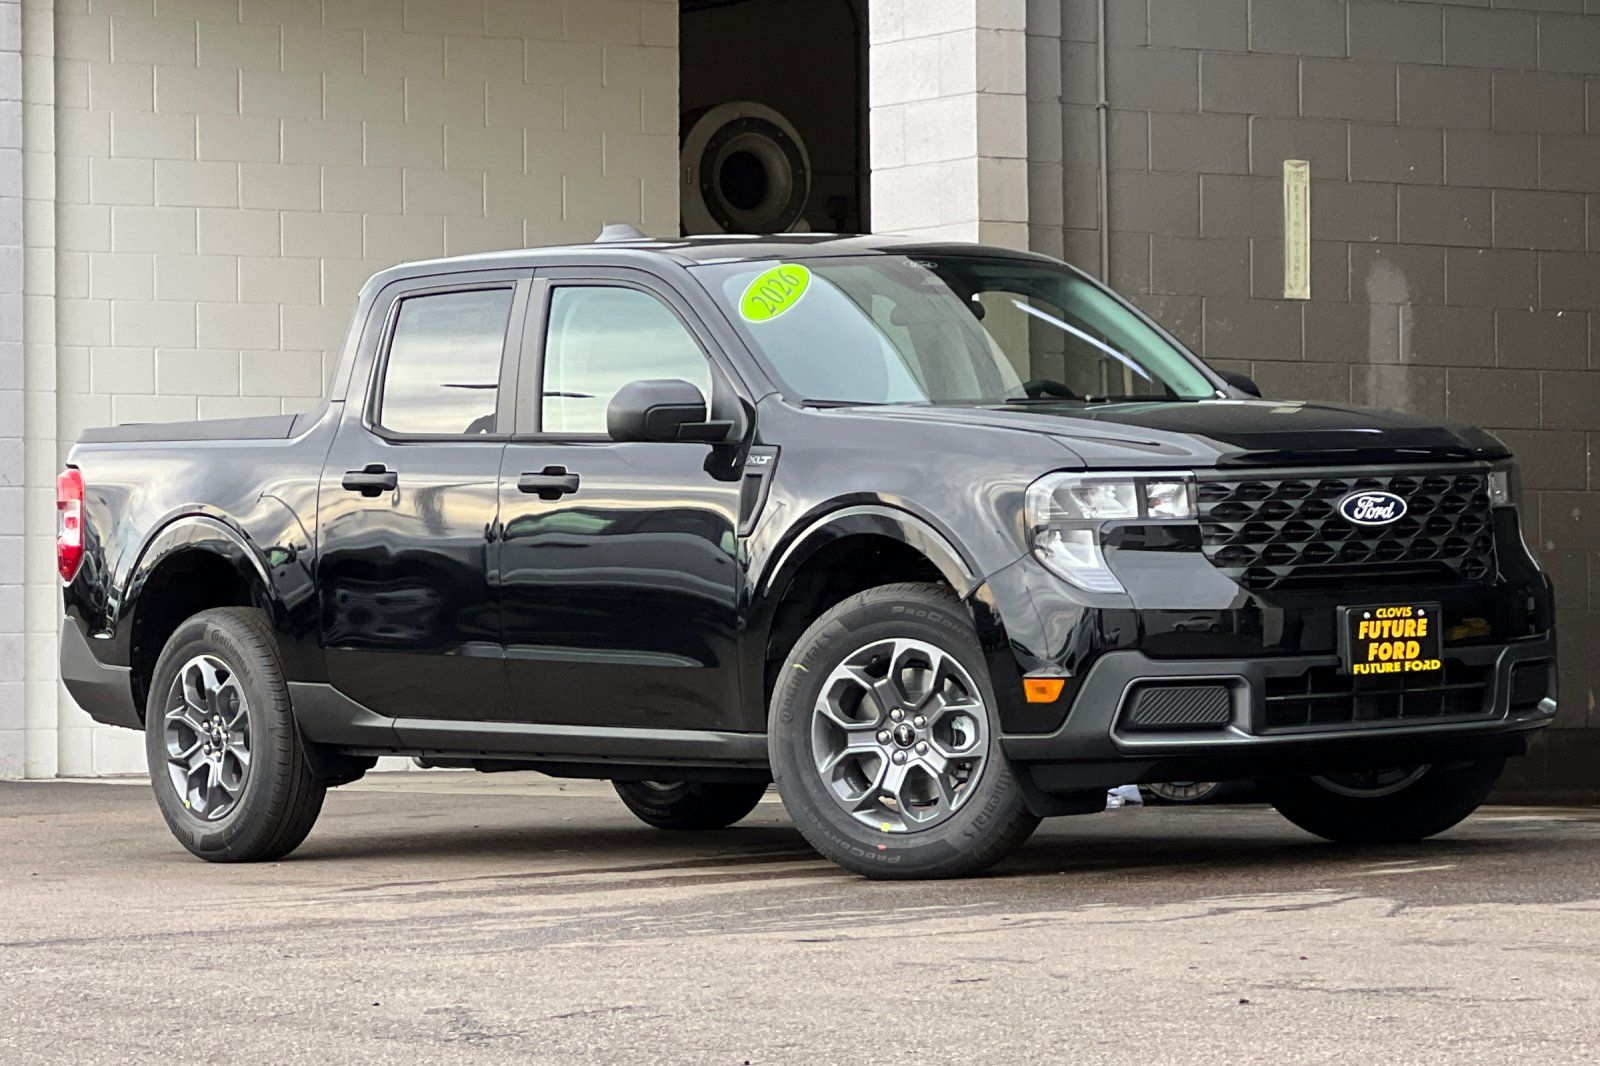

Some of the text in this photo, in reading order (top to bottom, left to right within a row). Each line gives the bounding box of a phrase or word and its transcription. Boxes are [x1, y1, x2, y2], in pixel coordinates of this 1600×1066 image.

[751, 269, 800, 314] 2026
[746, 455, 772, 464] XLT
[1353, 496, 1395, 519] Ford
[1376, 606, 1412, 618] CLOVIS
[1359, 618, 1427, 639] FUTURE
[1368, 640, 1420, 661] FORD
[1353, 659, 1441, 675] FUTURE FORD
